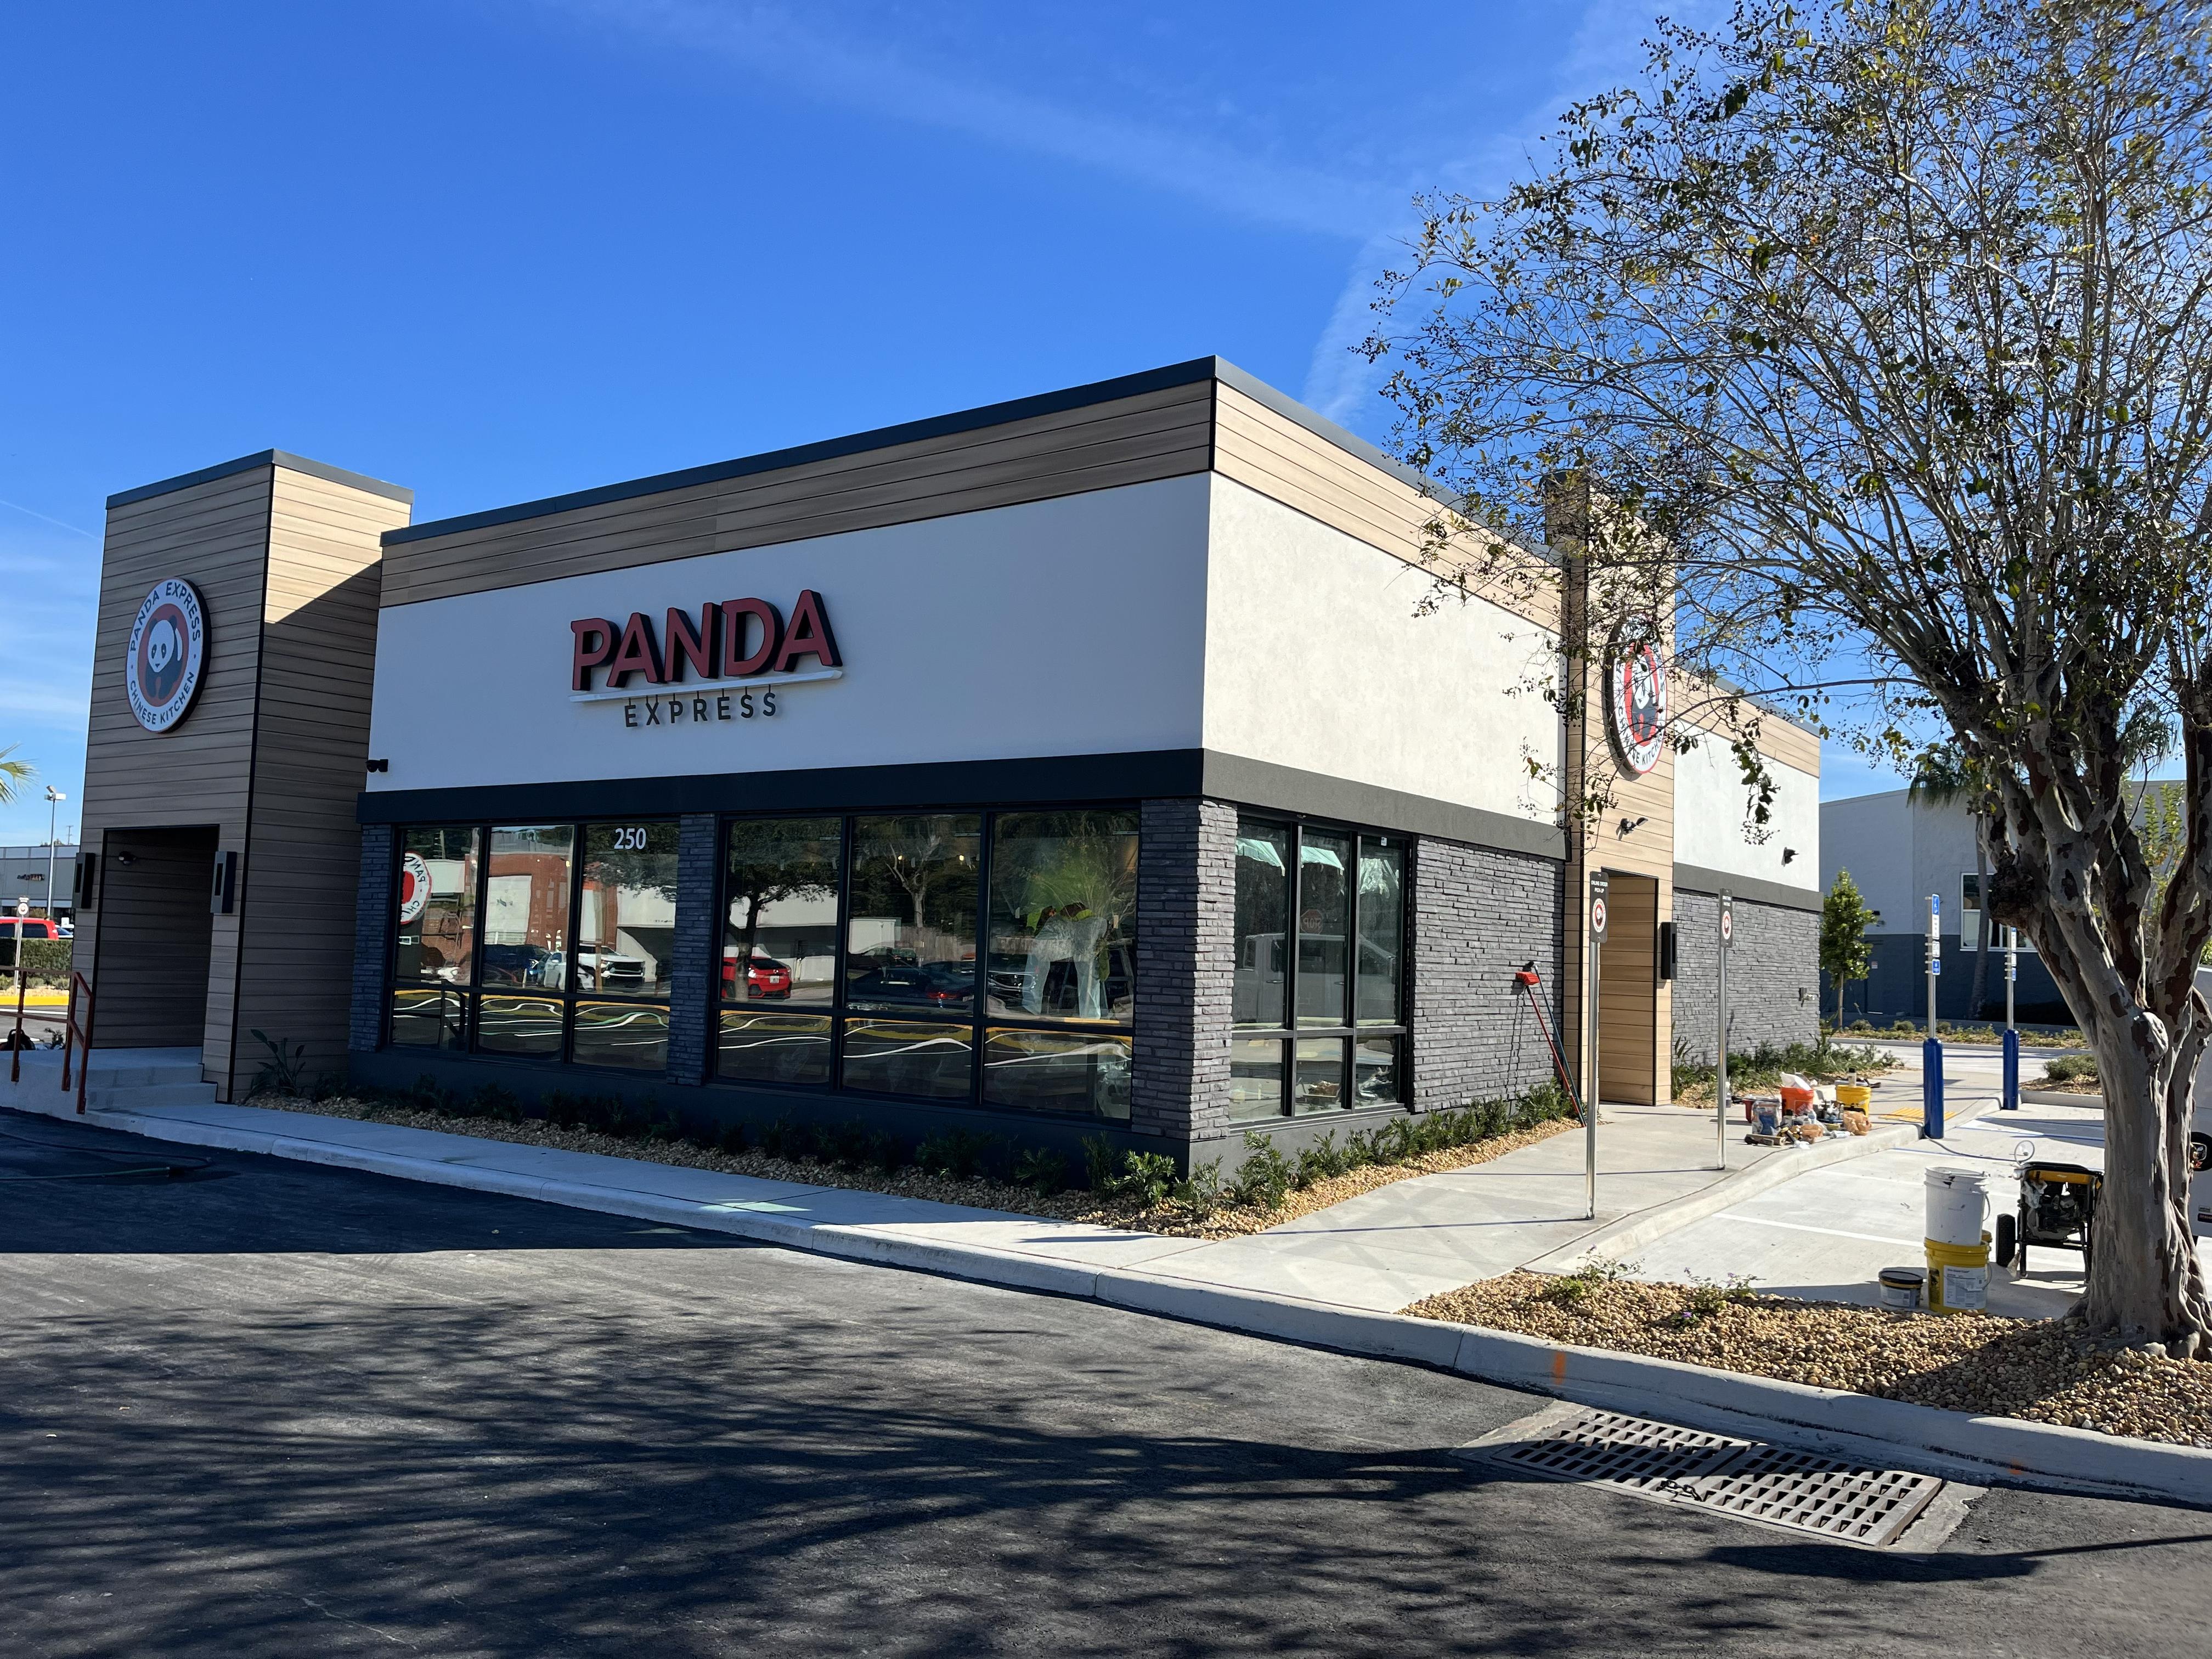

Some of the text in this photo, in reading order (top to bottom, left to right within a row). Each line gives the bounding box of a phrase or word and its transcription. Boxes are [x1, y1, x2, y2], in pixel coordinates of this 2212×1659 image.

[130, 582, 201, 652] PANDA EXPRESS
[571, 589, 843, 691] PANDA
[130, 672, 194, 725] CHINESE KITCHEN
[624, 692, 776, 727] EXPRESS
[614, 828, 646, 849] 250
